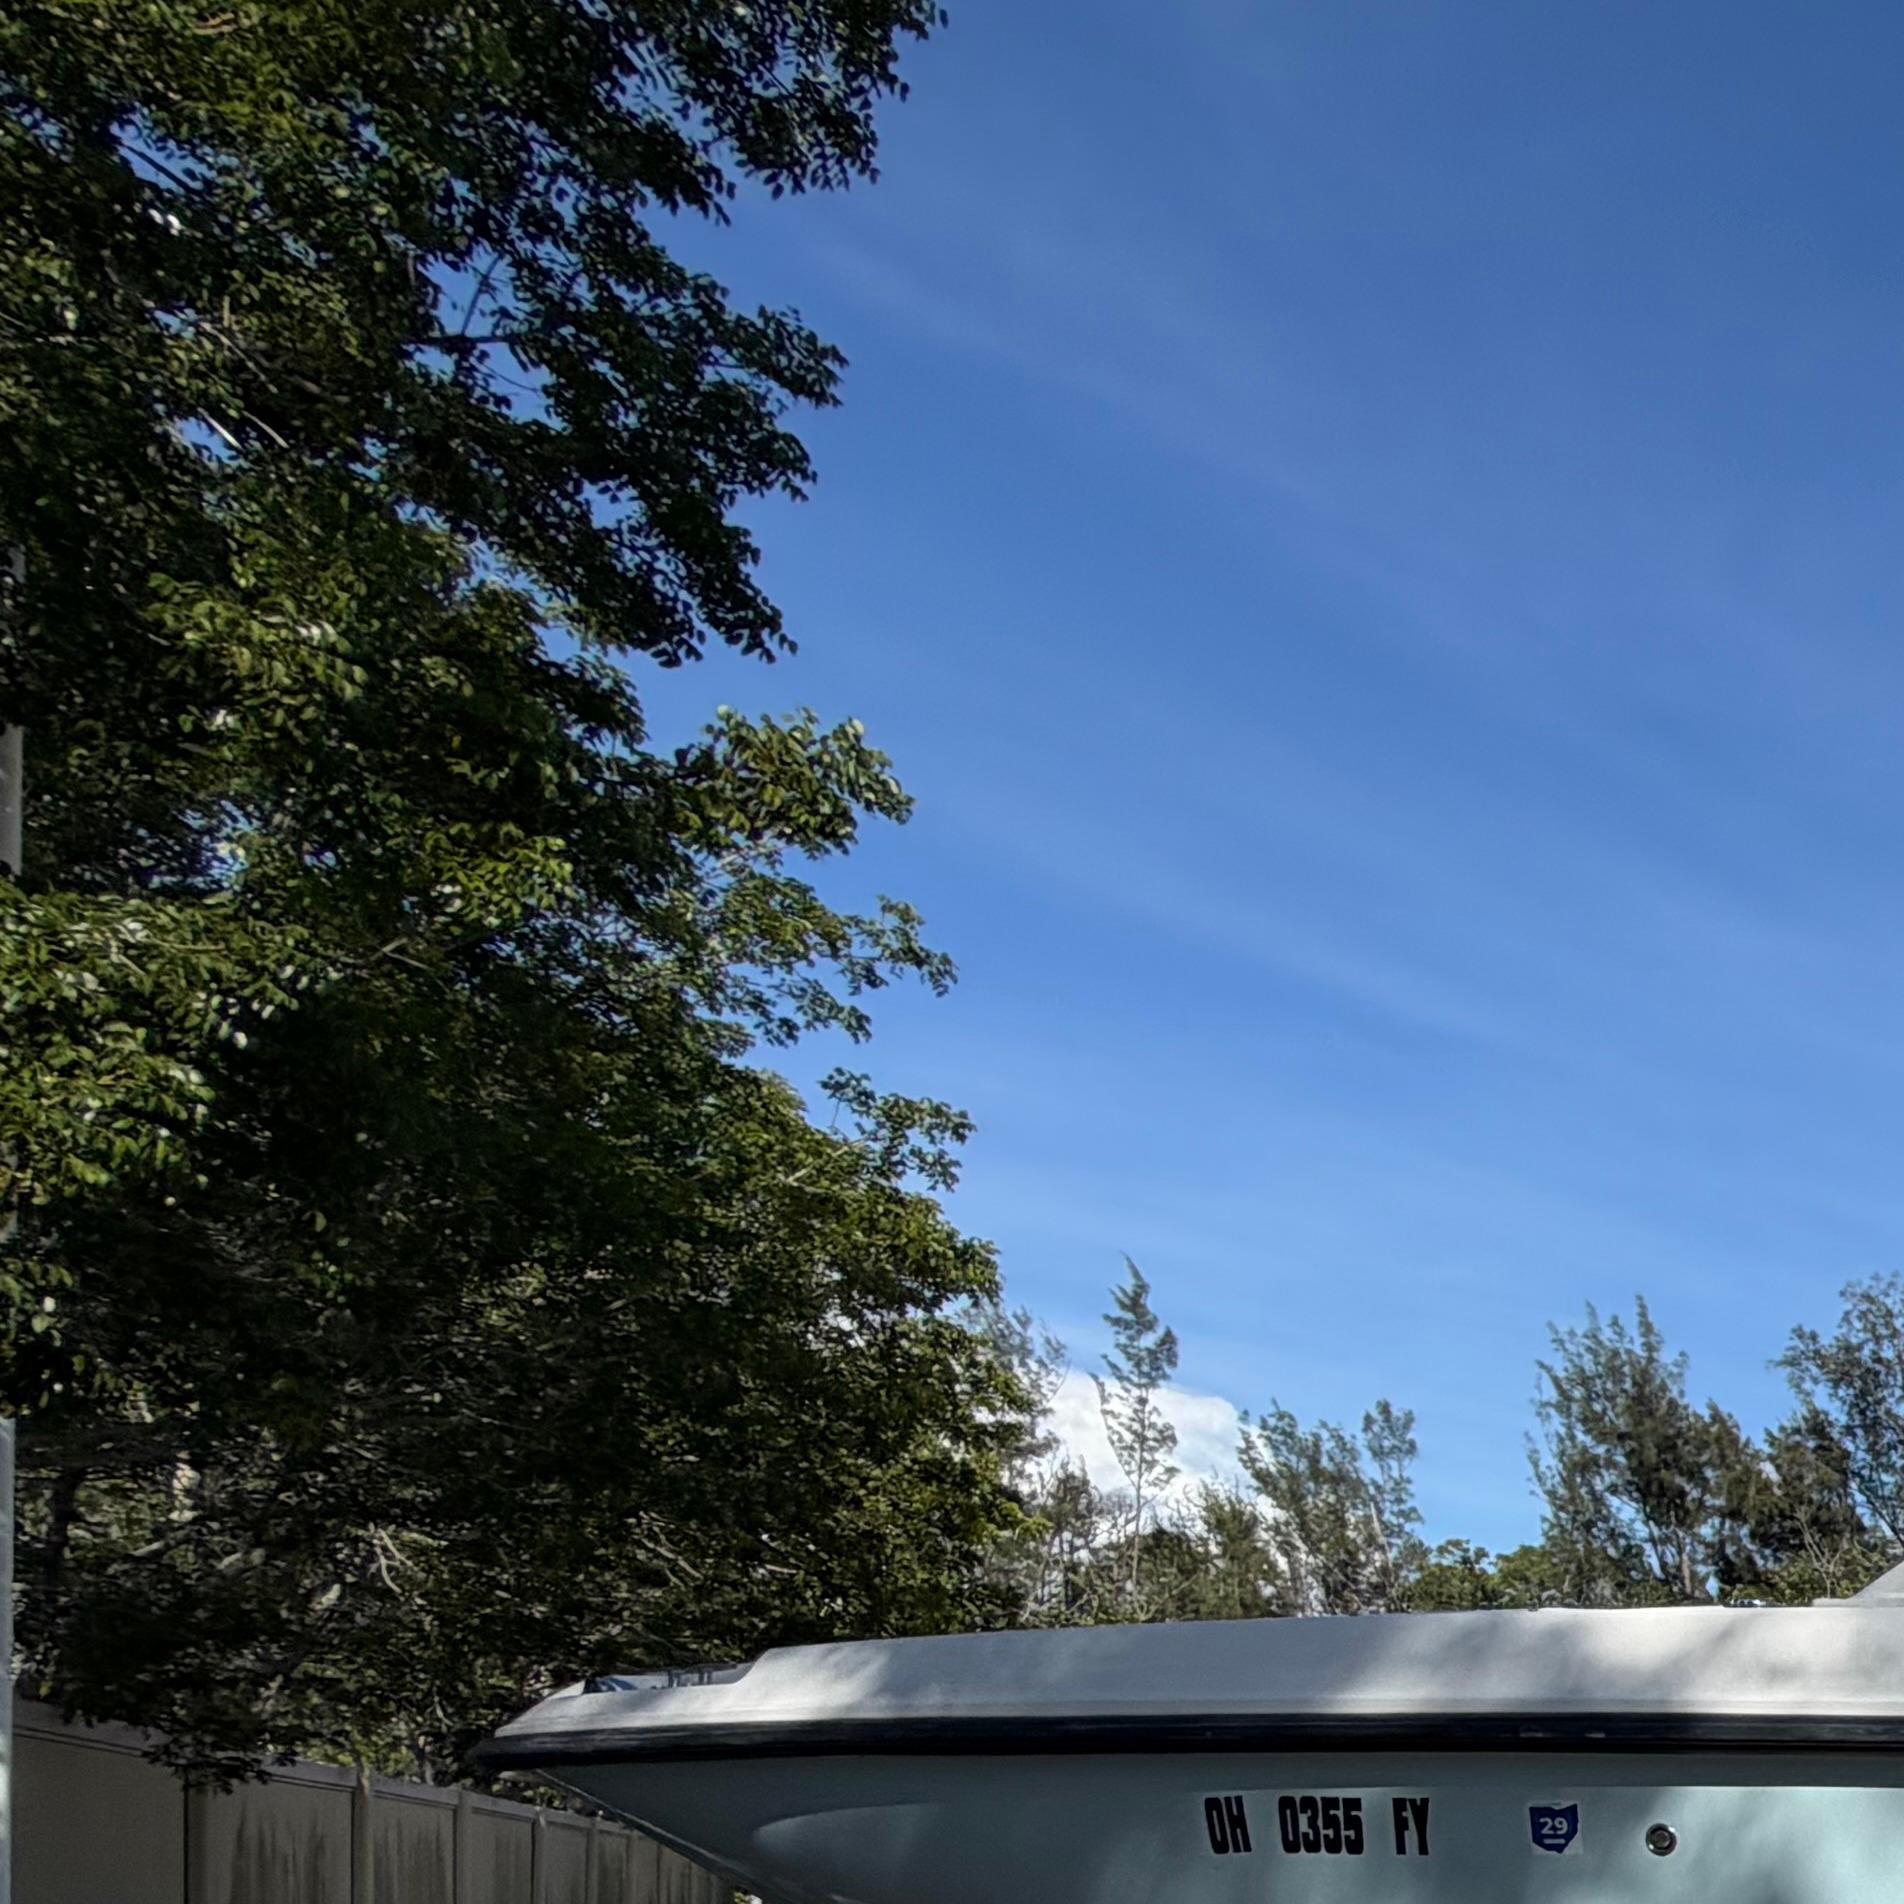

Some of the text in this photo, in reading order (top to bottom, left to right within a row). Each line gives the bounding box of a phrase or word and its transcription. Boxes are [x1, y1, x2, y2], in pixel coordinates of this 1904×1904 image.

[1204, 1796, 1430, 1856] OH 0355 FY
[1539, 1817, 1569, 1835] 29
